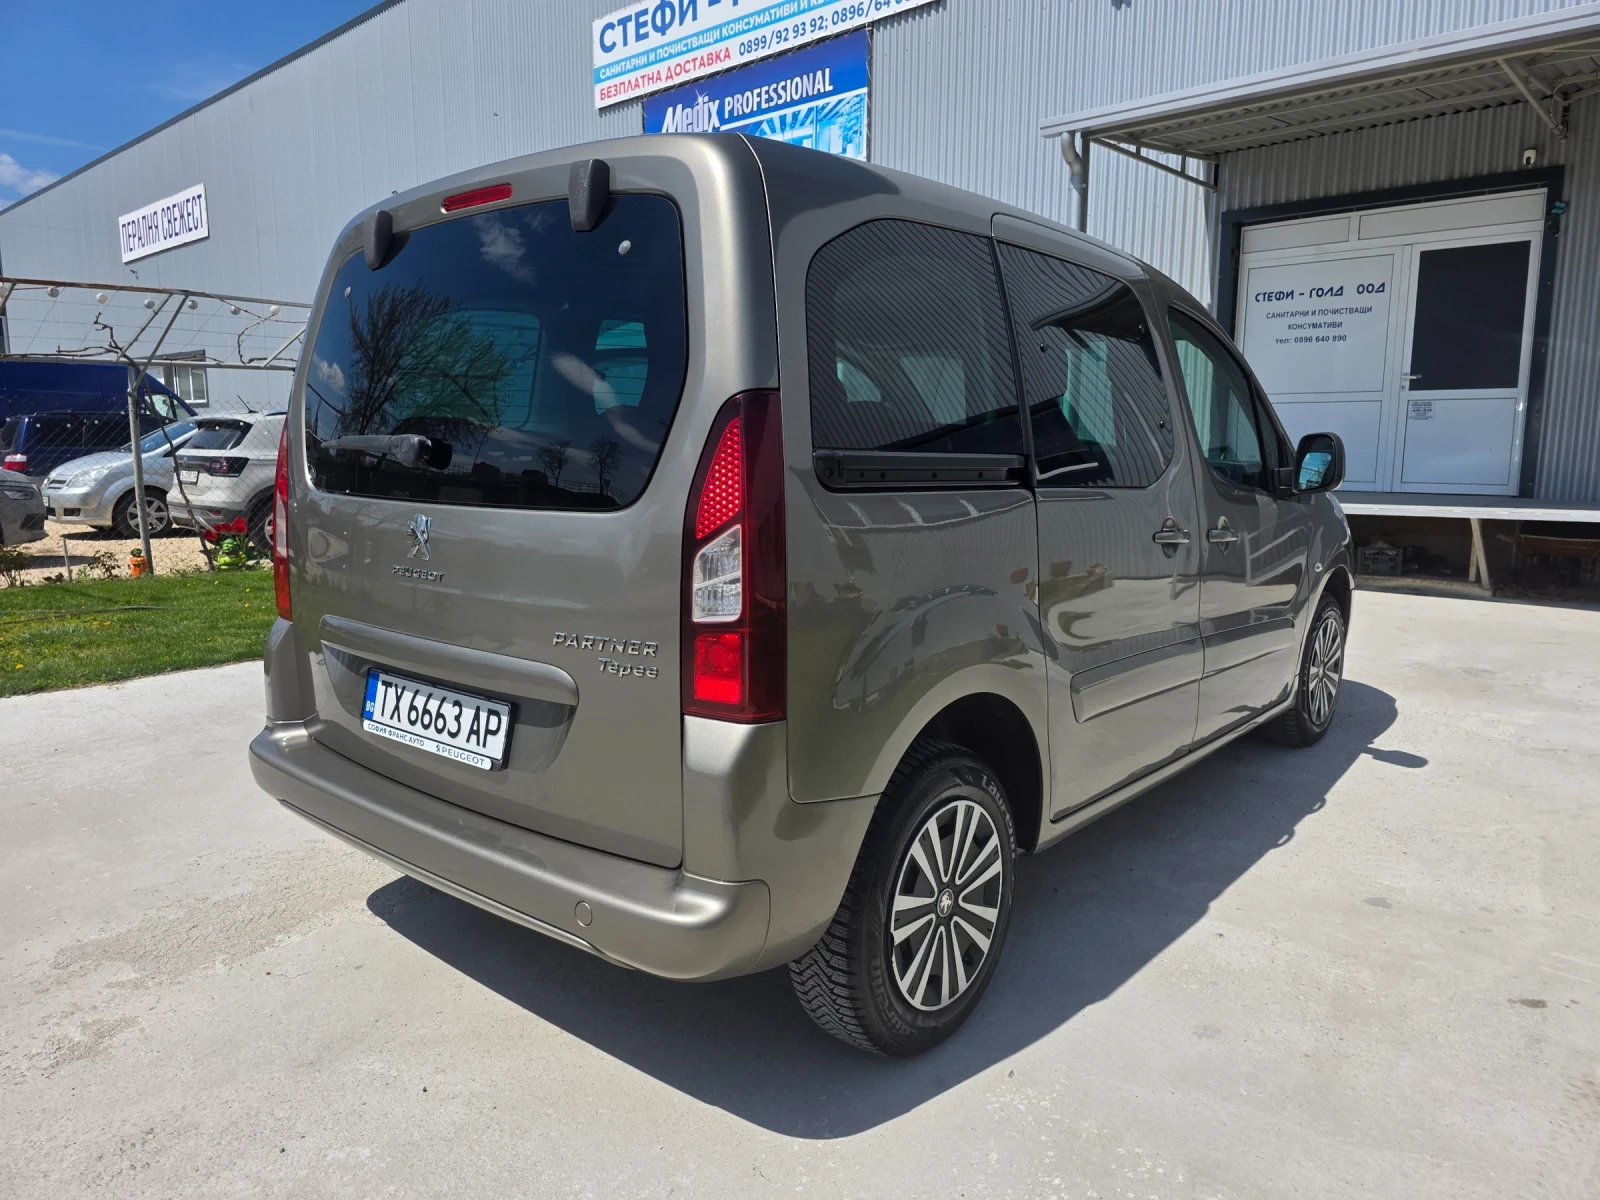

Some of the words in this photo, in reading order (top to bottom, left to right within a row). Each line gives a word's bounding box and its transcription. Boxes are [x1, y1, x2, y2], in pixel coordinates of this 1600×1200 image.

[598, 0, 698, 54] СТЕФИ
[599, 54, 648, 79] САНИТАРНИ
[648, 51, 656, 62] И
[656, 28, 720, 59] ПОЧИСТВАЩИ
[721, 4, 798, 38] КОНСУМАТИВИ
[599, 70, 663, 101] БЕЗПЛАТНА
[665, 47, 732, 83] ДОСТАВКА
[738, 27, 790, 56] 0899/92
[792, 21, 807, 39] 93
[661, 94, 721, 133] Medix
[724, 67, 834, 120] PROFESSIONAL
[121, 210, 161, 255] ПЕРАЛНЯ
[161, 193, 204, 241] СВЕЖЕСТ
[1254, 289, 1295, 303] СТЕФИ
[1309, 285, 1345, 299] ГОЛД
[1356, 282, 1386, 295] ООД
[1266, 309, 1310, 320] САНИТАРНИ
[1310, 309, 1317, 317] И
[1318, 306, 1373, 317] ПОЧИСТВАЩИ
[1287, 321, 1343, 331] КОНСУМАТИВИ
[1294, 335, 1313, 344] 0896
[1315, 335, 1330, 343] 640
[1331, 334, 1347, 343] 890
[392, 565, 445, 582] PEUGEOT
[552, 631, 659, 657] PARTNER
[598, 657, 660, 679] Tepee
[365, 700, 375, 713] BG
[367, 723, 387, 735] СОФИЯ
[387, 729, 408, 742] ФРАНС
[408, 737, 425, 747] АУТО
[441, 746, 486, 767] PEUGEOT
